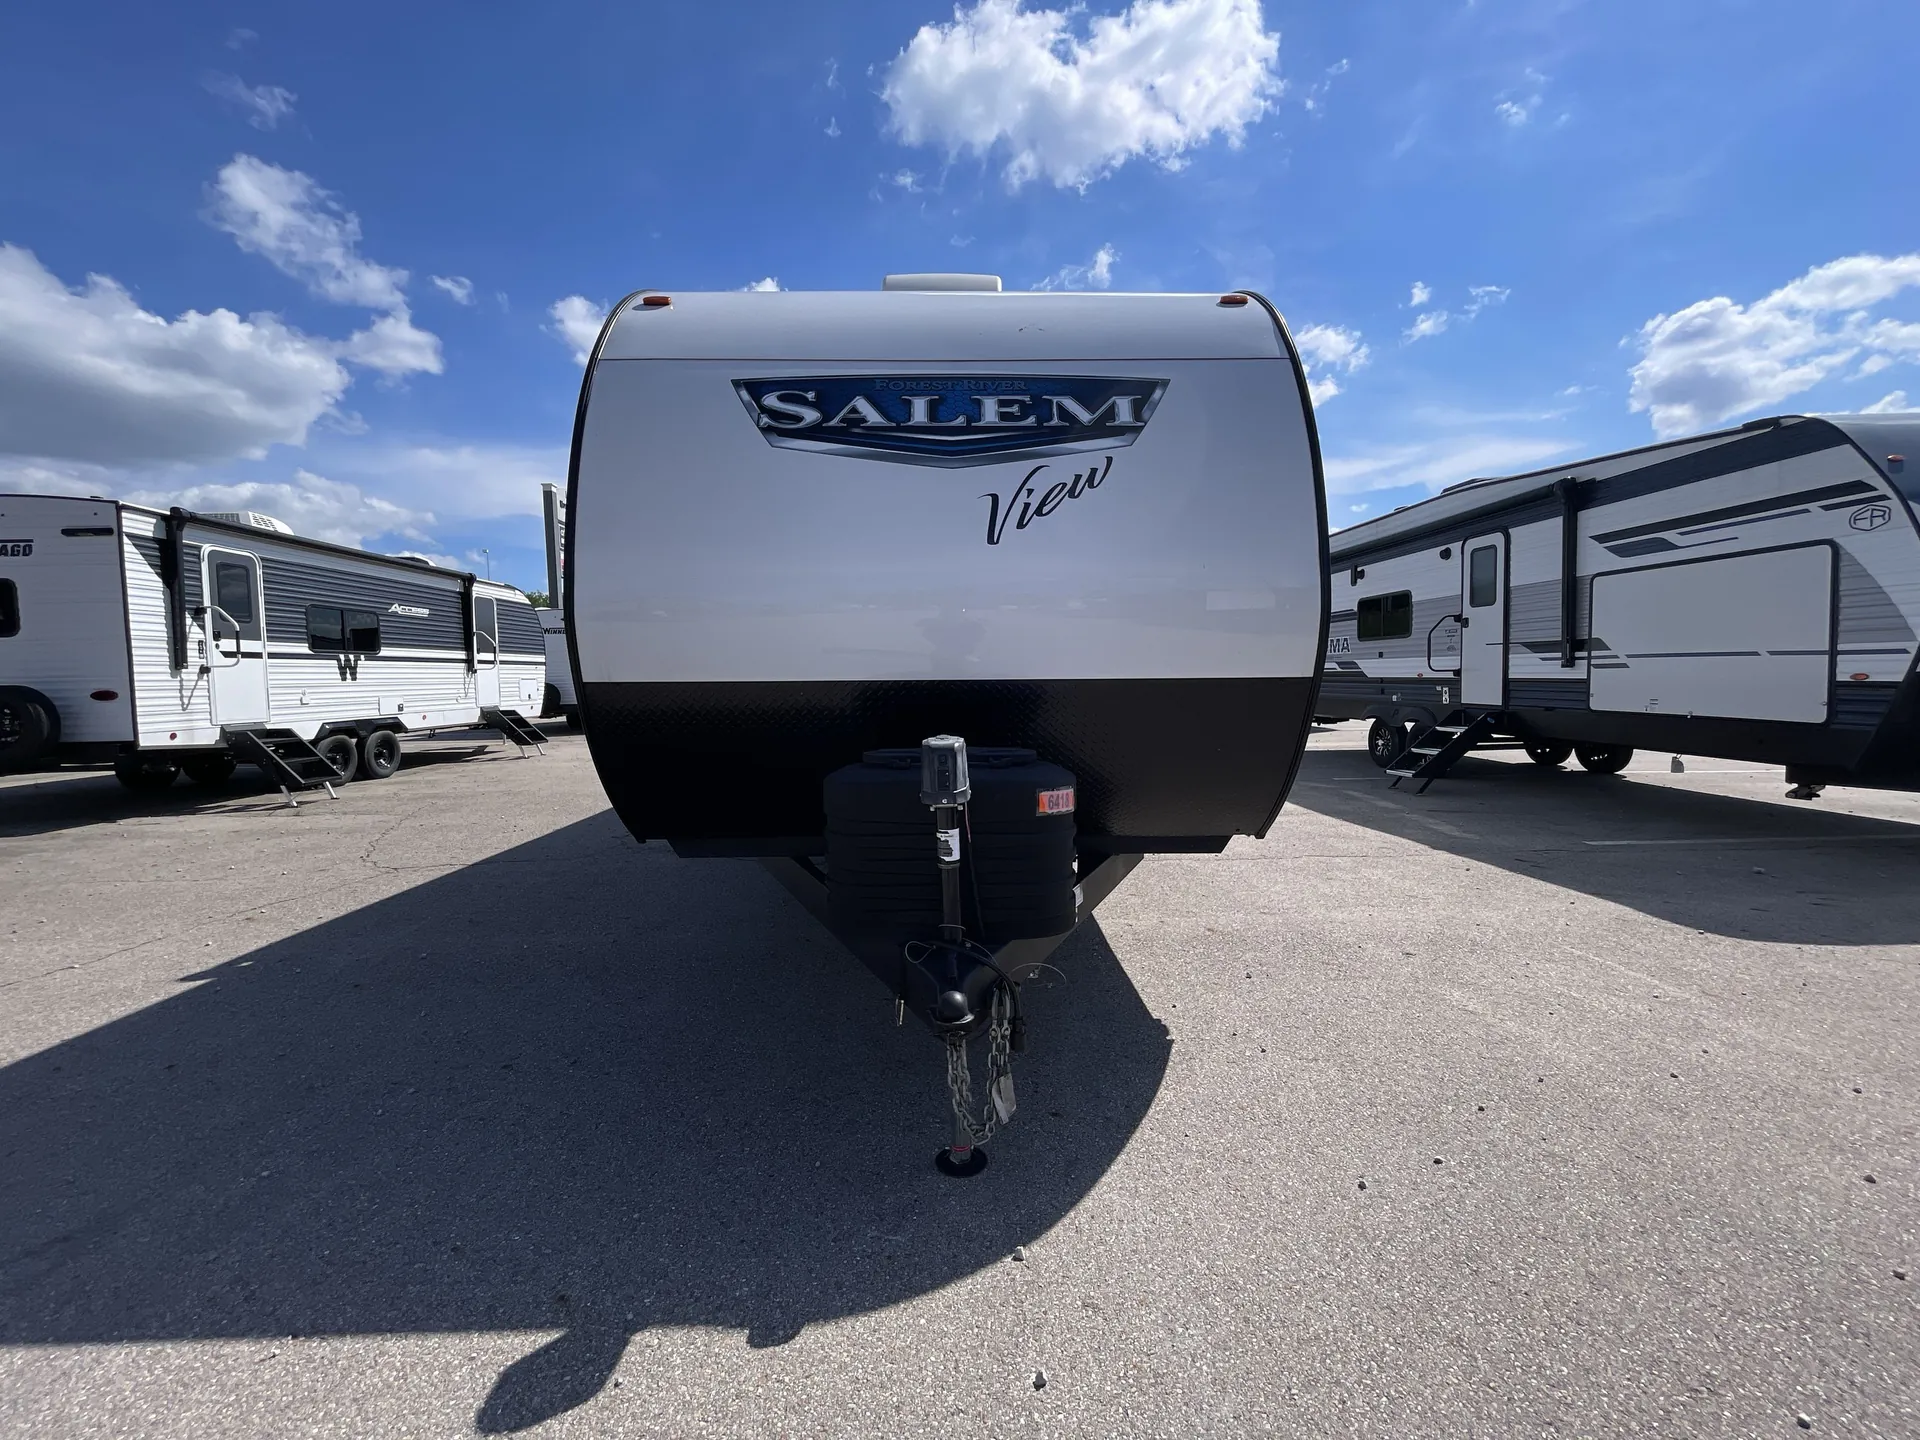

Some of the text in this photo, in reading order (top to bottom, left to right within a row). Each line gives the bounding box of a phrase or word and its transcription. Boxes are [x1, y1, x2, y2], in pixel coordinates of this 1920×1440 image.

[874, 379, 1028, 391] FOREST RIVER
[758, 390, 1147, 429] SALEM
[977, 456, 1113, 545] View
[0, 543, 33, 557] AGO
